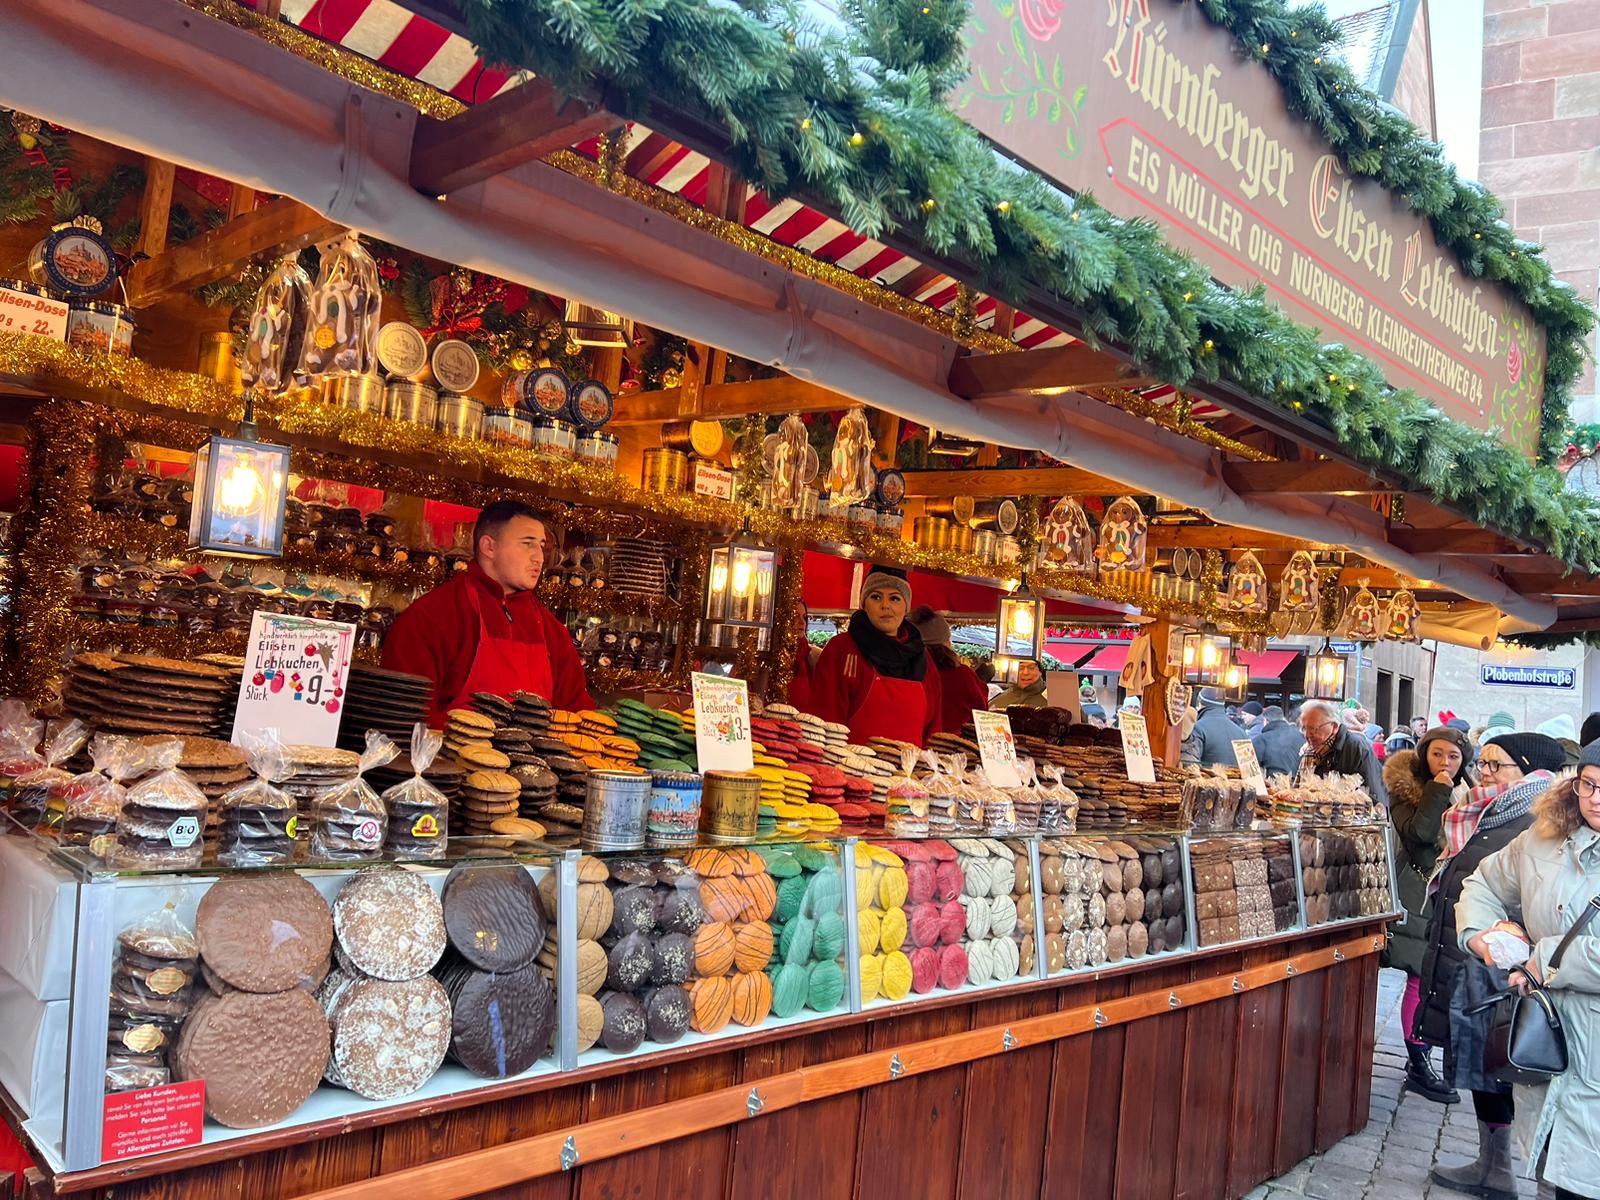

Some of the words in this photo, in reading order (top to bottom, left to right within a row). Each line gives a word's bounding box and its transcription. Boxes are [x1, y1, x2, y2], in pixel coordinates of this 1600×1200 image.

[1309, 154, 1393, 282] Elisen
[1400, 231, 1500, 359] Lebkuchen
[1128, 135, 1161, 194] EIS
[1166, 163, 1243, 252] MÜLLER
[1248, 223, 1283, 276] OHG
[1289, 251, 1364, 330] NÜRNBERG
[1366, 304, 1470, 398] KLEINREUTHERWEG
[1469, 373, 1483, 405] 84
[0, 290, 66, 317] lisen-Dose
[258, 640, 295, 651] Elisen
[256, 655, 320, 669] Lebkuchen
[1485, 667, 1571, 685] Plobenhofstraße
[245, 685, 268, 701] Stück
[701, 701, 740, 713] Lebkuchen
